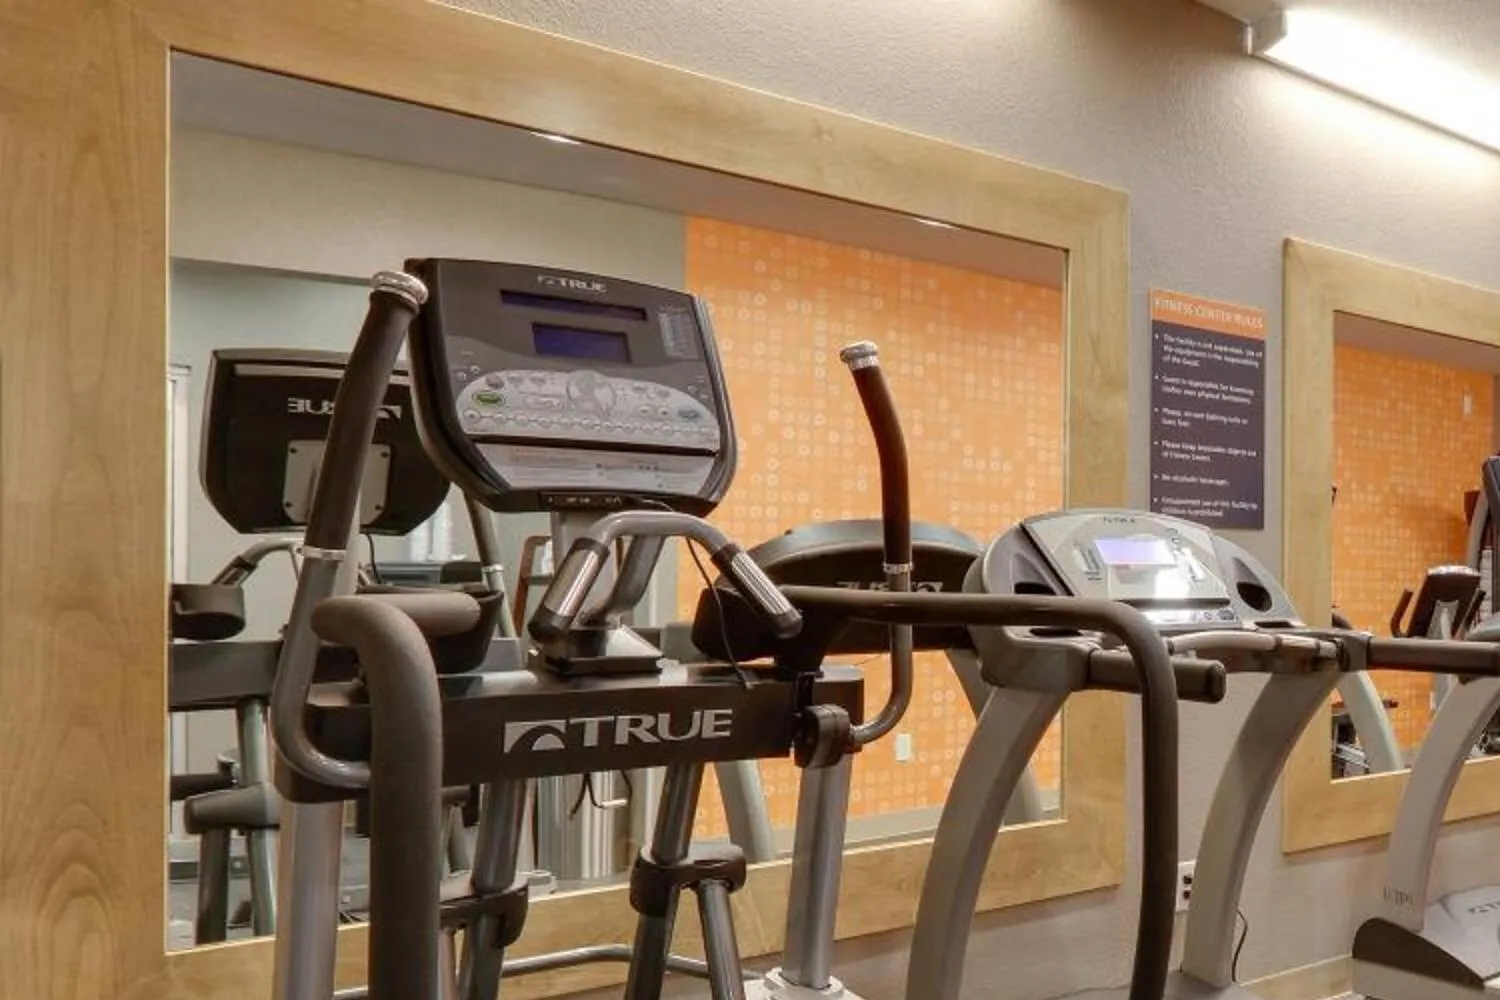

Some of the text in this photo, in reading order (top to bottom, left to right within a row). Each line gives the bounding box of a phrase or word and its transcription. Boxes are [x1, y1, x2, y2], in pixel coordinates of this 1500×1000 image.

[559, 277, 607, 293] TRUE
[1155, 299, 1194, 316] FITNESS
[569, 708, 733, 748] TRUE
